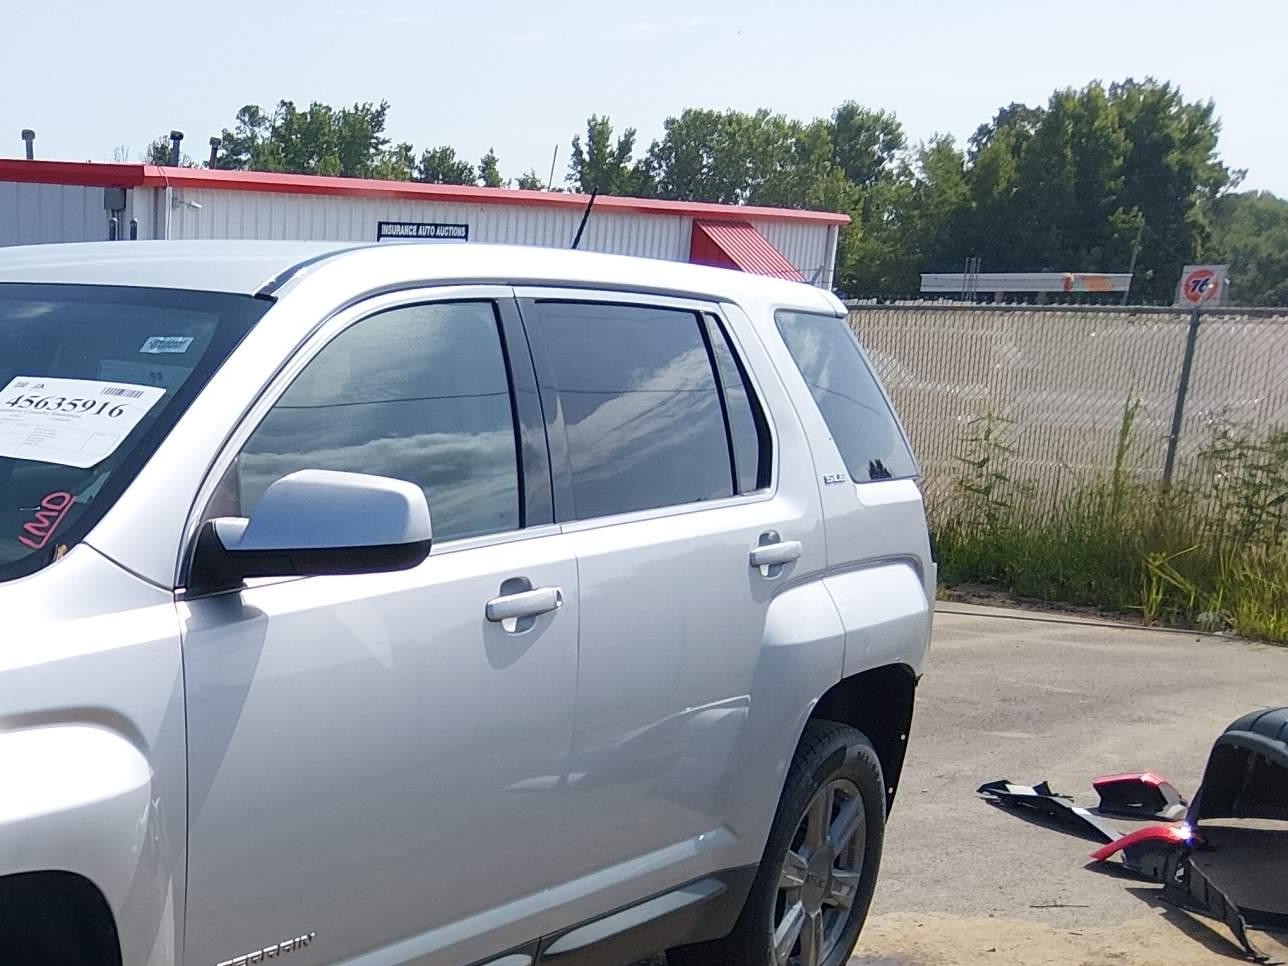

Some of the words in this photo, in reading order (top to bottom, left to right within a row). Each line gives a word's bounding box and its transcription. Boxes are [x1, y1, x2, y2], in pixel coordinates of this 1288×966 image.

[380, 223, 418, 236] INSURANCE
[418, 225, 435, 236] AUTO
[435, 225, 466, 237] AUCTIONS
[5, 394, 129, 418] 45635916
